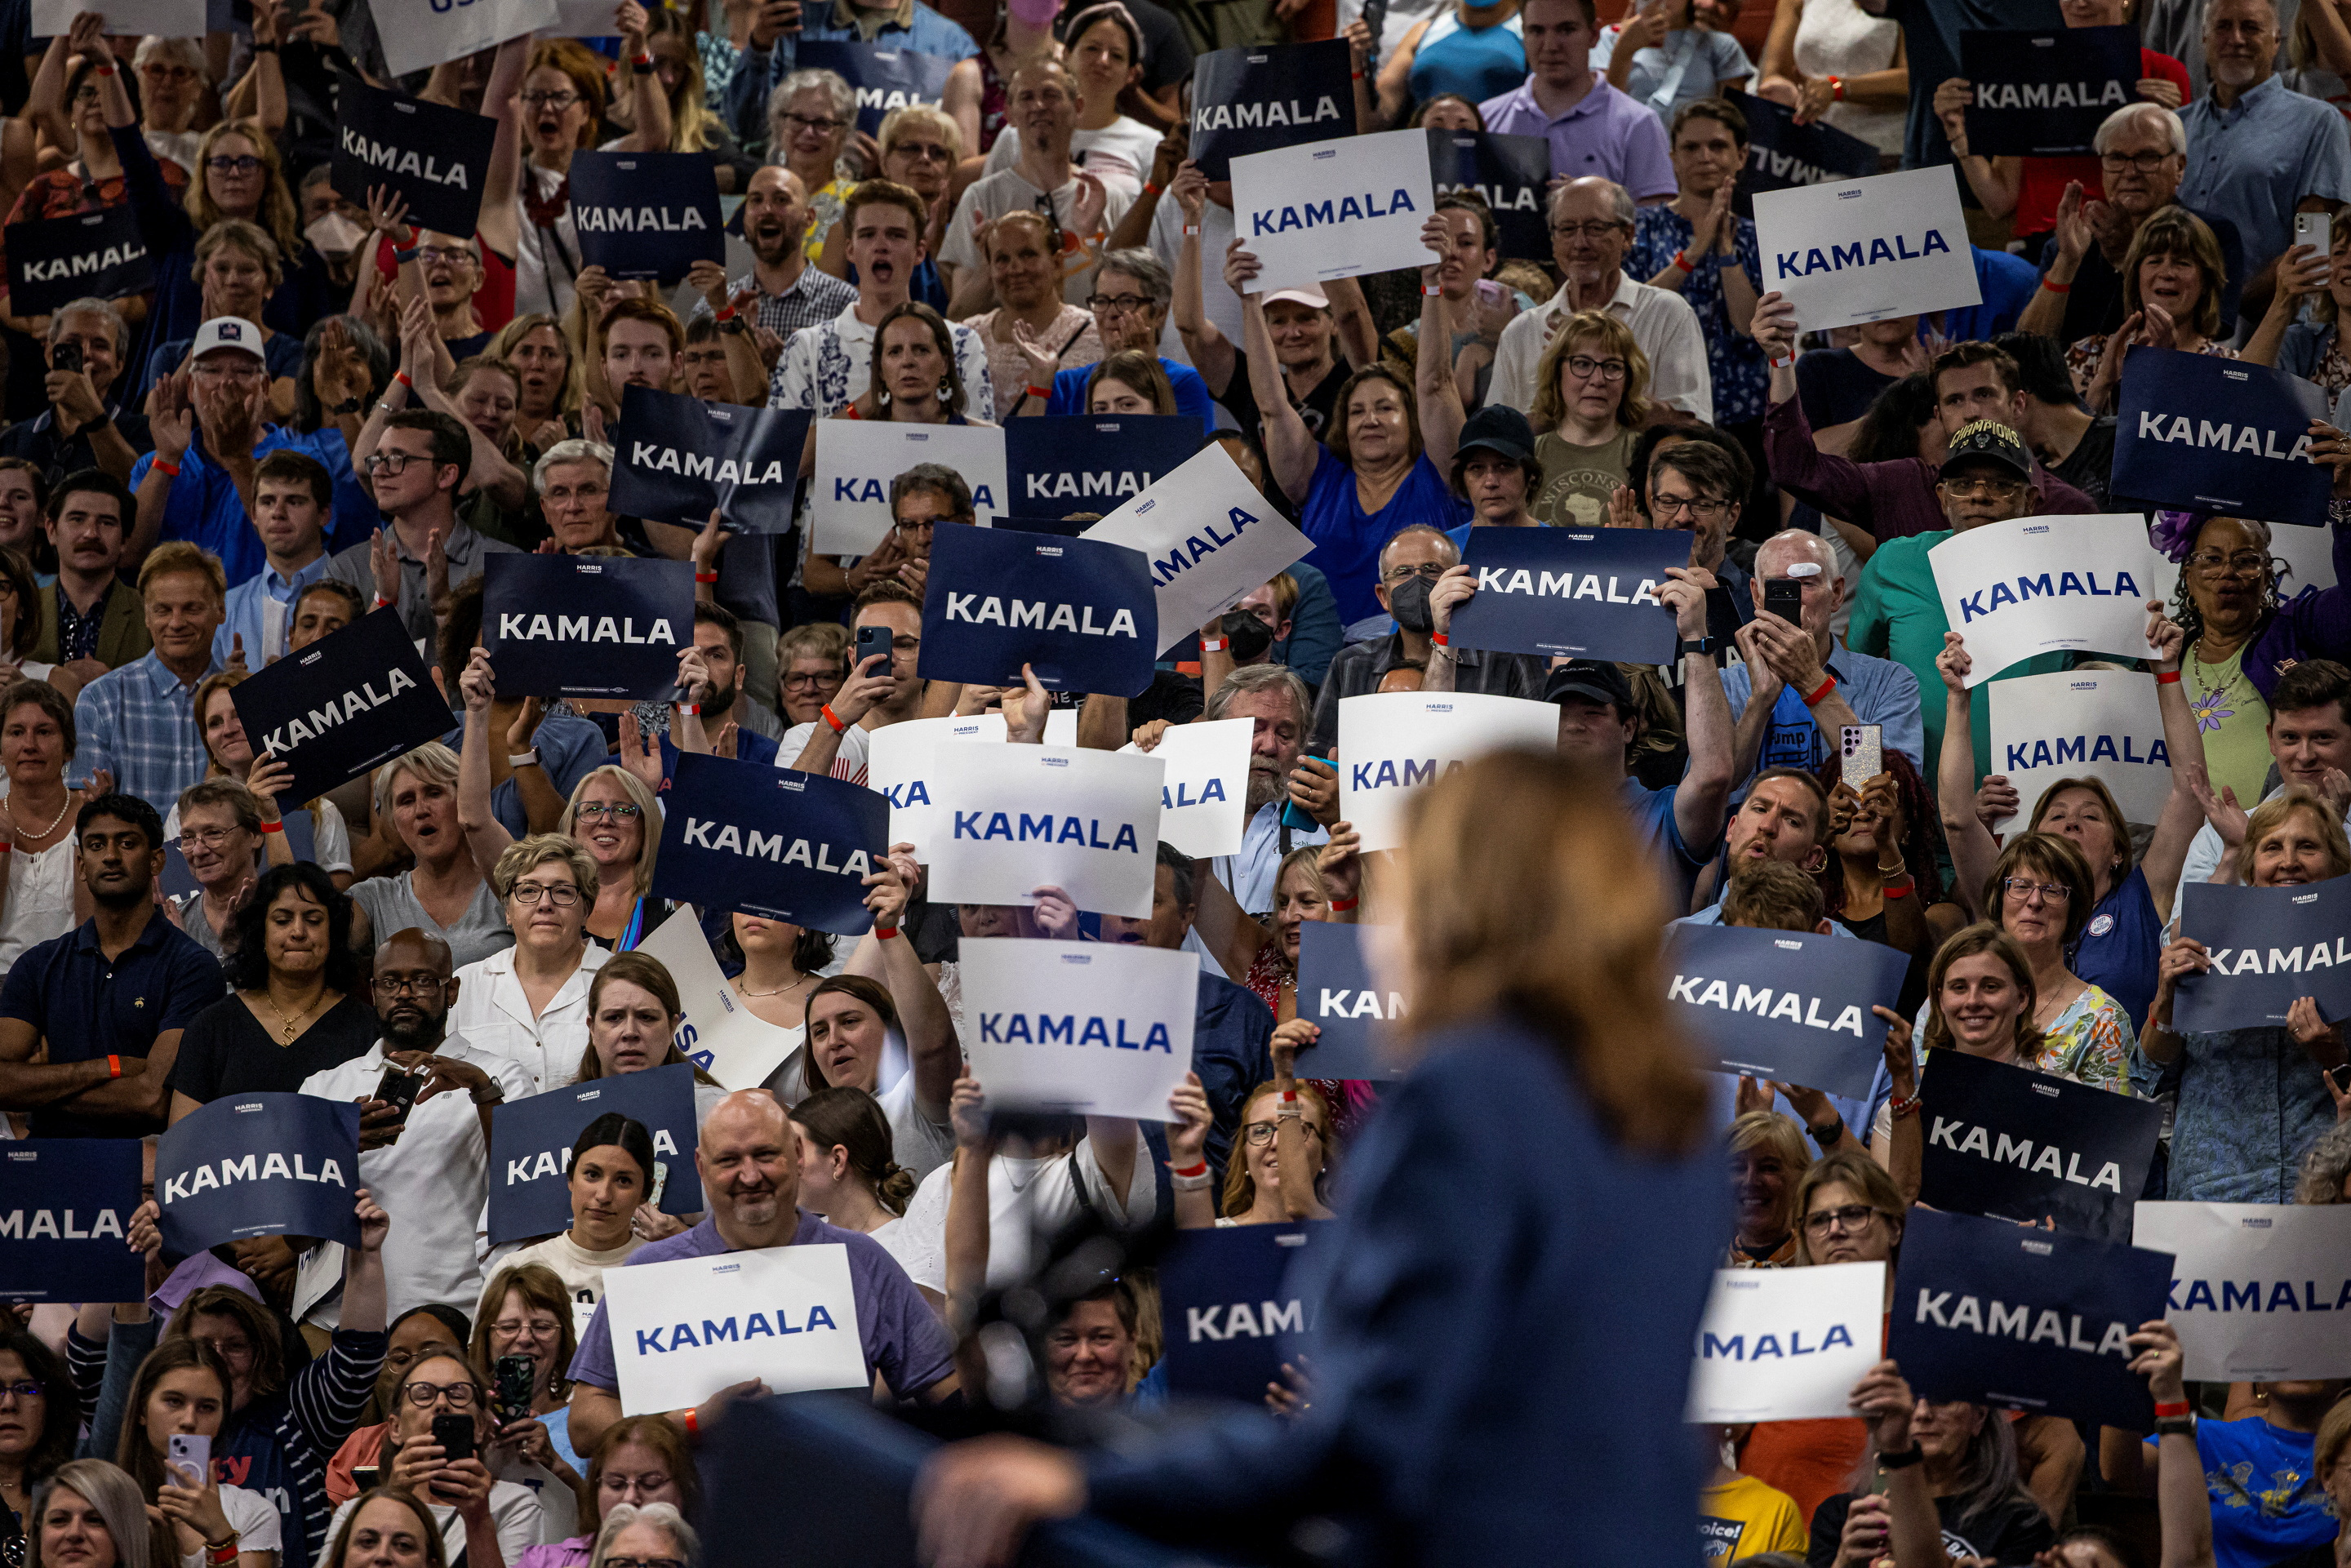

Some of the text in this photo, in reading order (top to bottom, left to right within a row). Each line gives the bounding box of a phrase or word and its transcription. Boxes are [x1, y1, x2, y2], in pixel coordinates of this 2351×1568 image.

[1195, 96, 1340, 132] KAMALA
[1977, 80, 2126, 109] KAMALA
[342, 125, 468, 189] KAMALA
[1253, 189, 1415, 237] KAMALA
[1838, 189, 1862, 198] HARRIS
[576, 207, 708, 232] KAMALA
[24, 242, 148, 282] KAMAL
[1778, 229, 1951, 279] KAMALA
[2223, 369, 2248, 379] HARRIS
[1949, 419, 2020, 449] CHAMPIONS
[2138, 411, 2313, 464] KAMALA
[631, 442, 784, 485] KAMALA
[1135, 499, 1155, 514] HARRIS
[1541, 473, 1619, 508] WISCONS
[1478, 566, 1660, 606] KAMALA
[1960, 572, 2140, 624] KAMALA
[500, 615, 676, 645] KAMALA
[946, 592, 1138, 639] KAMALA
[300, 651, 322, 664] HARRIS
[262, 667, 416, 757] KAMALA
[2007, 735, 2169, 771] KAMALA
[778, 780, 806, 789] HARRIS
[684, 817, 871, 877] KAMALA
[953, 811, 1138, 855] KAMALA
[2291, 893, 2318, 902] HARRIS
[2207, 936, 2351, 976] KAMAL
[719, 989, 735, 1013] HARRIS
[1668, 975, 1864, 1037] KAMALA
[676, 1012, 716, 1073] SA
[980, 1012, 1173, 1055] KAMALA
[577, 1090, 601, 1099] HARRIS
[2032, 1082, 2060, 1095] HARRIS
[1929, 1116, 2121, 1194] KAMALA
[164, 1153, 347, 1205] KAMALA
[637, 1305, 838, 1356] KAMALA
[1915, 1287, 2131, 1358] KAMALA
